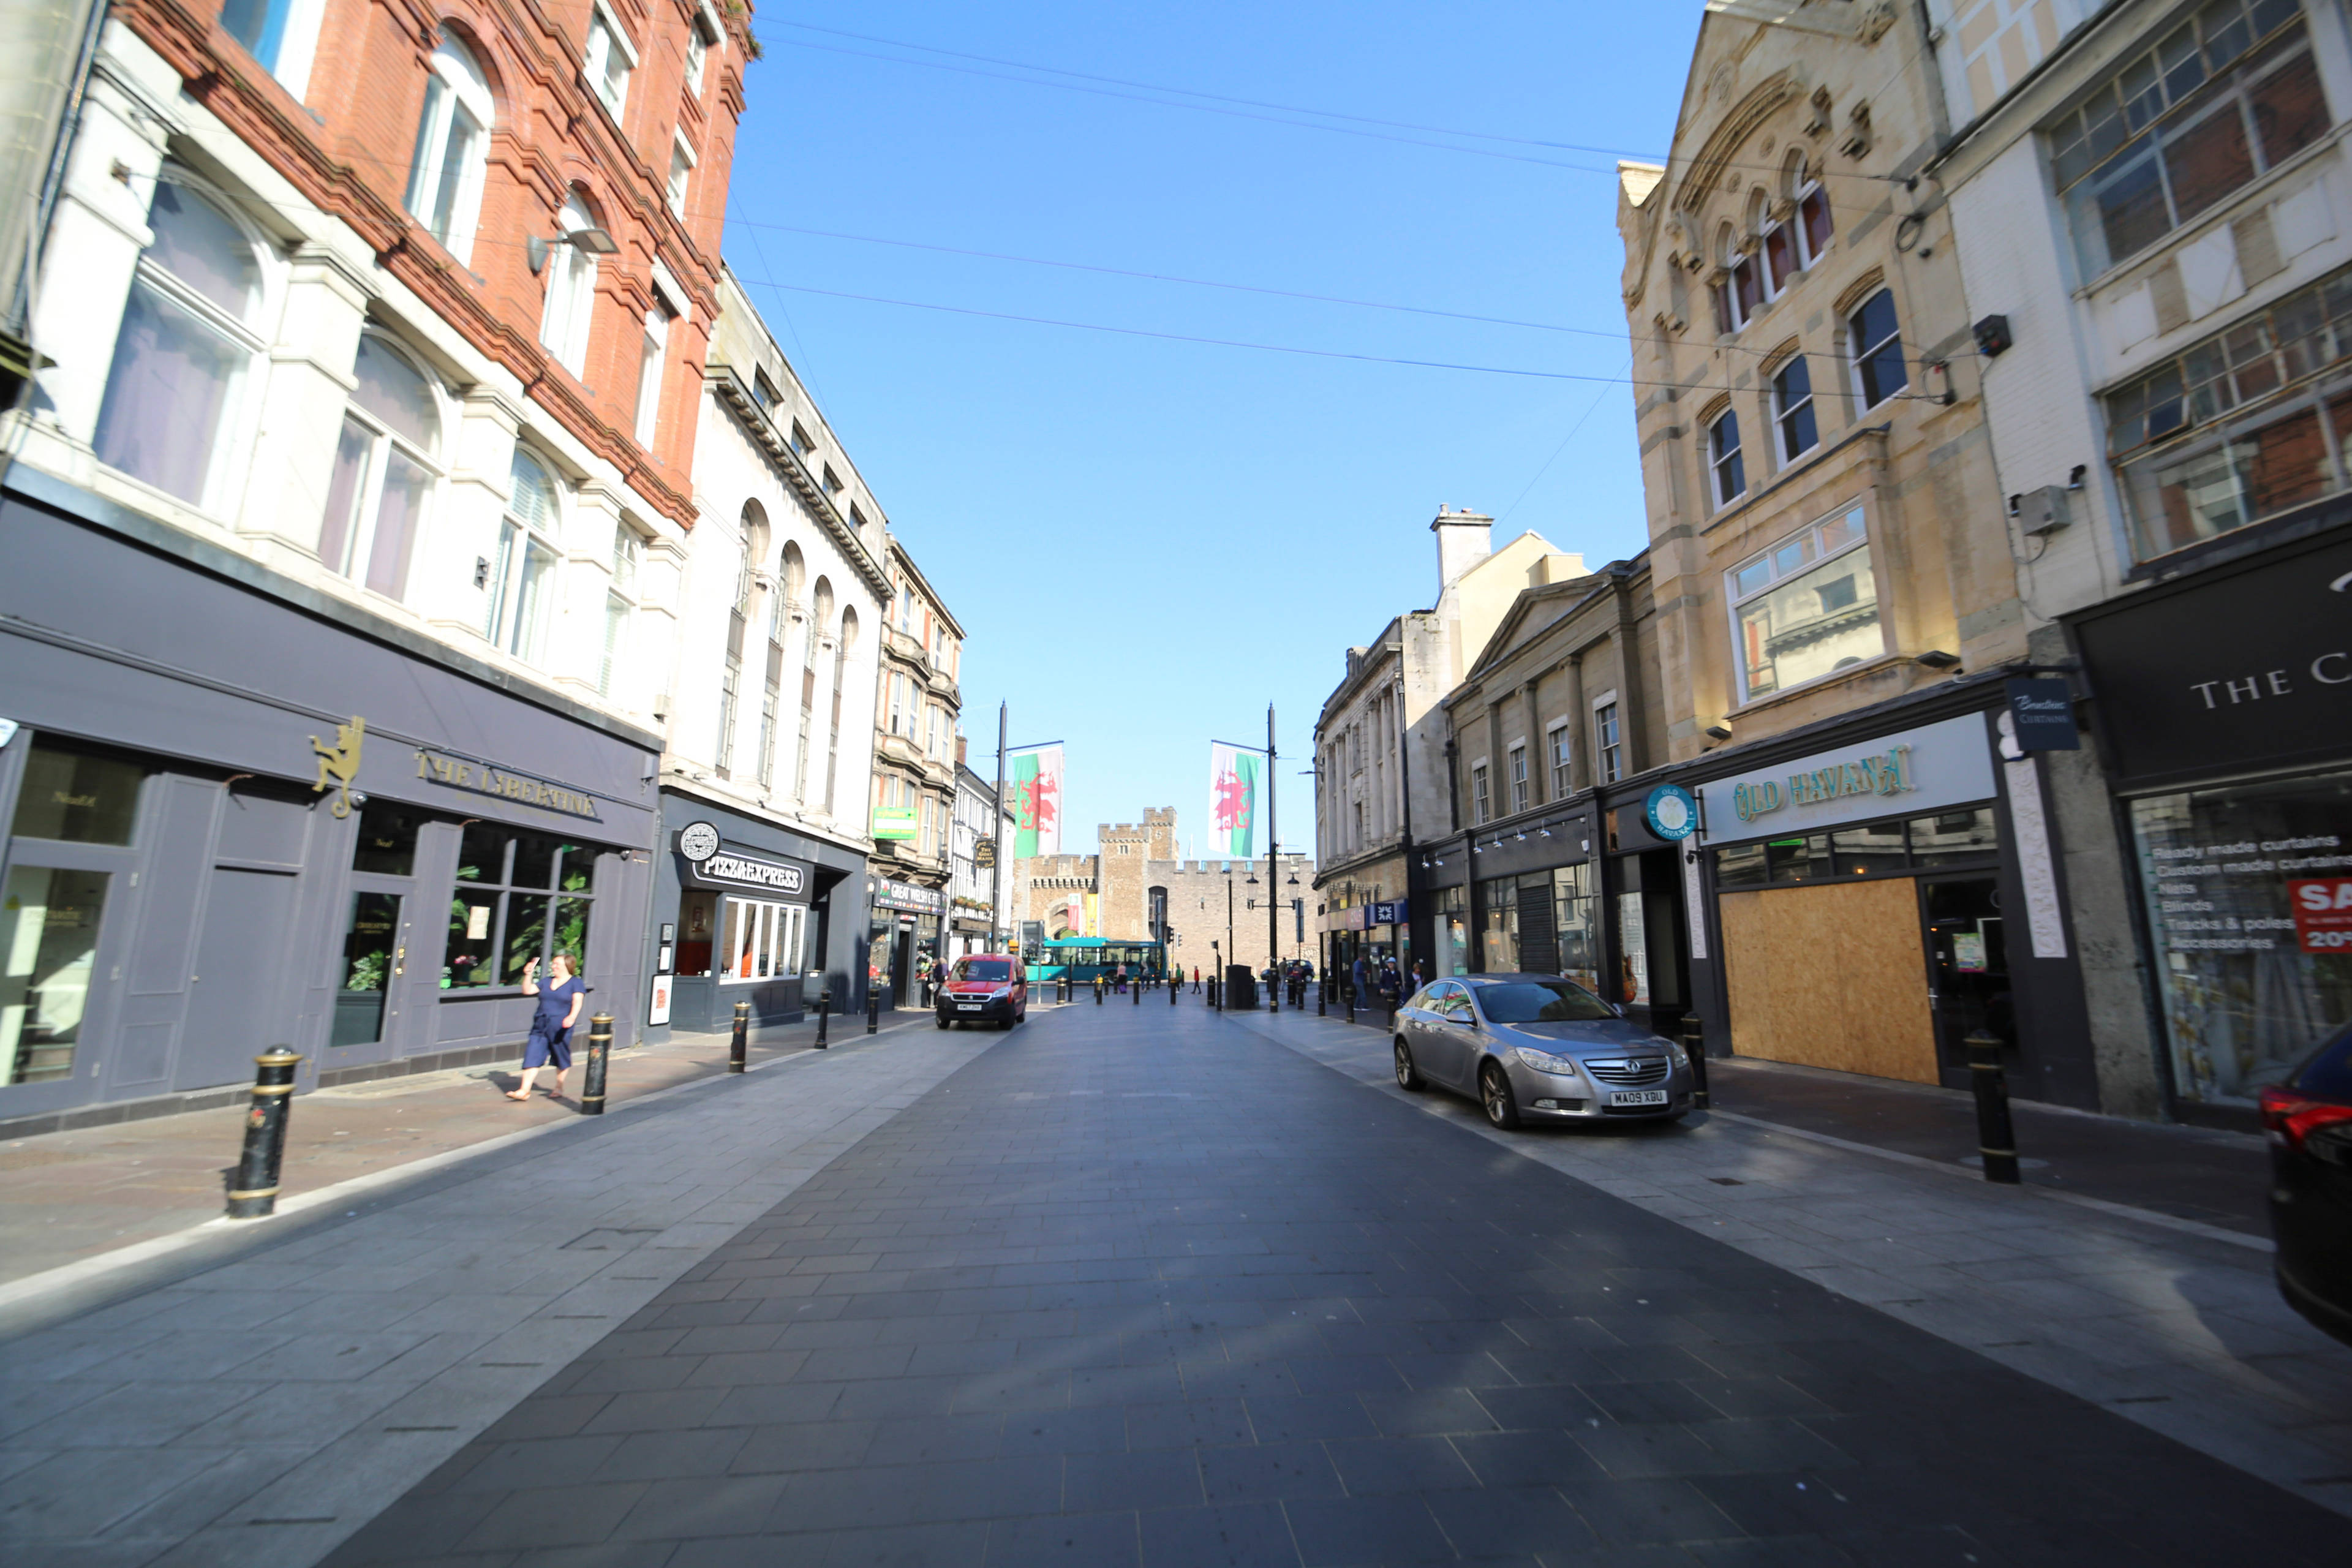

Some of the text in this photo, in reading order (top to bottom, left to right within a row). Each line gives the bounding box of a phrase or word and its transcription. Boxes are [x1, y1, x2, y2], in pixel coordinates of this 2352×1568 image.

[2190, 669, 2293, 709] THE
[414, 752, 472, 787] THE
[480, 770, 597, 817] LIBERTINE
[1733, 743, 1915, 822] OLD HAVANA
[1657, 824, 1691, 837] HAVANA
[2152, 835, 2340, 859] Ready made curtains
[704, 856, 799, 888] PIZZAEXPRESS
[2155, 864, 2221, 878] Custom
[2223, 858, 2275, 873] made
[891, 884, 910, 900] GREAT
[910, 888, 927, 903] WELSH
[2162, 900, 2214, 913] Blinds
[2165, 918, 2221, 931] Tracks
[2225, 917, 2240, 930] &
[2242, 918, 2296, 933] poles
[2169, 936, 2275, 949] Accessories
[1615, 1092, 1642, 1103] MA09
